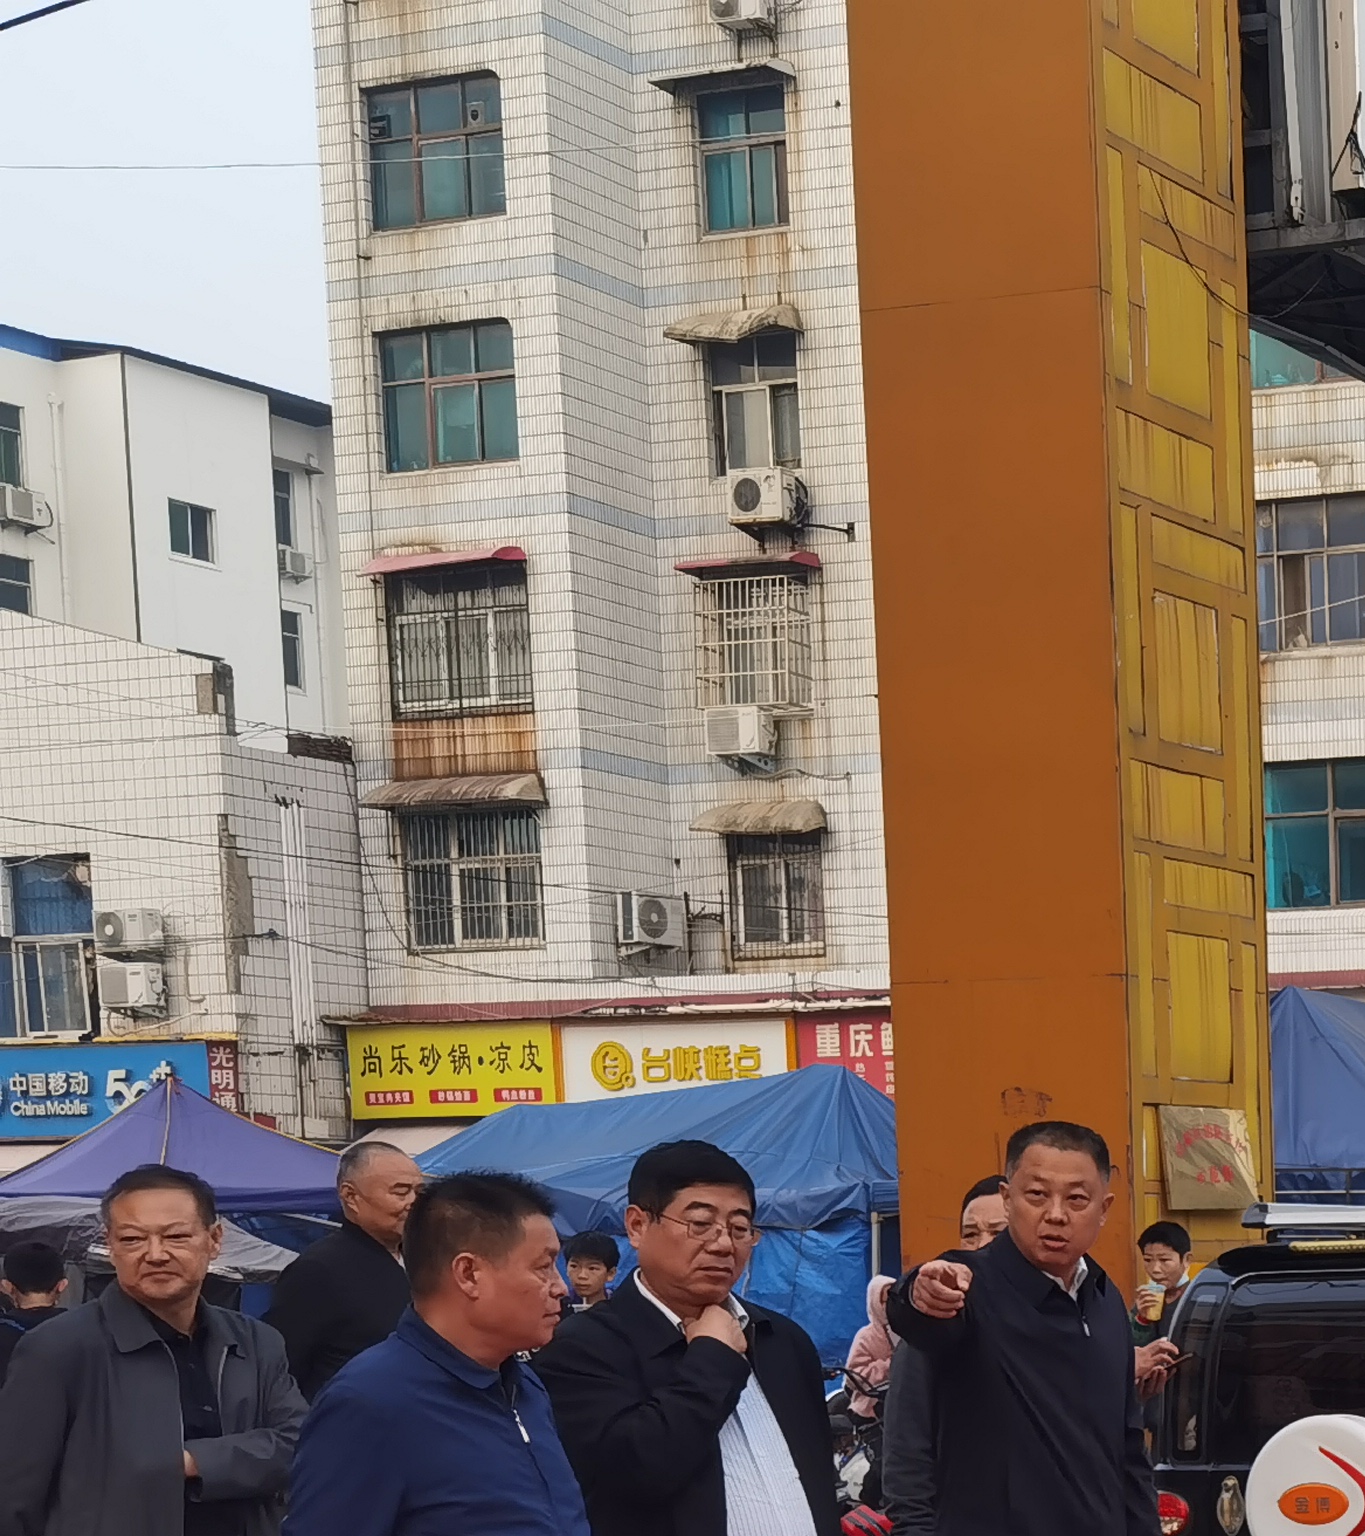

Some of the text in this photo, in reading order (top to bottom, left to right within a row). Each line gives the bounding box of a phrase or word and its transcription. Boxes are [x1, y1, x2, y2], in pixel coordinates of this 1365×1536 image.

[9, 1071, 89, 1098] 中国移动
[10, 1099, 88, 1116] China Mobile
[1295, 1496, 1330, 1514] 金博
